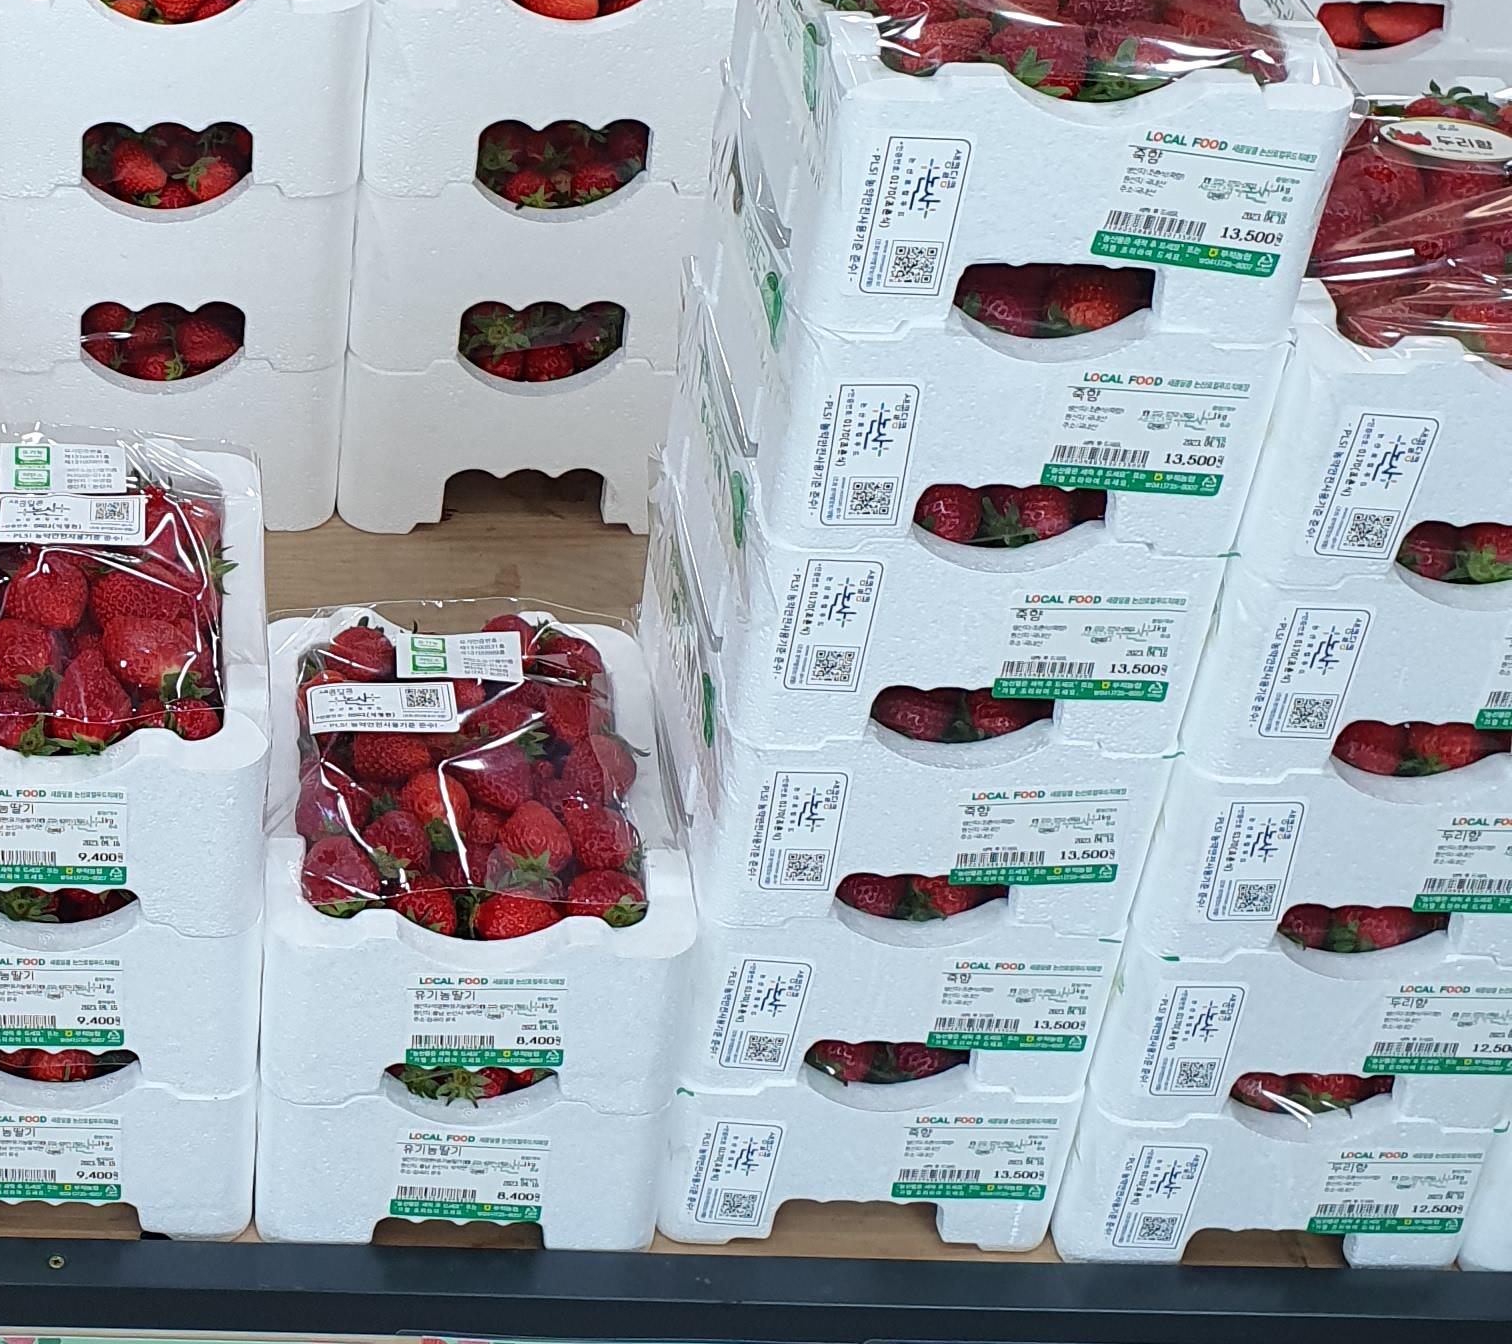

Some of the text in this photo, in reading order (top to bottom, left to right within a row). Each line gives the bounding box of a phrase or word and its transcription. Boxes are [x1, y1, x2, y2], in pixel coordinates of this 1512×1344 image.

[1146, 131, 1228, 151] LOCAL FOOD
[1436, 135, 1493, 150] 두리향
[1084, 371, 1163, 386] LOCAL FOOD
[1025, 594, 1102, 604] LOCAL FOOD
[16, 789, 46, 798] FOOD
[972, 790, 1045, 801] LOCAL FOOD
[1452, 817, 1490, 826] LOCAL
[17, 958, 46, 966] FOOD
[955, 961, 991, 970] LOCAL
[419, 977, 454, 985] LOCAL
[1399, 984, 1471, 994] LOCAL FOOD
[415, 990, 476, 1001] 유기농딸기
[916, 1116, 983, 1125] LOCAL FOOD
[409, 1133, 475, 1143] LOCAL FOOD
[403, 1144, 462, 1157] 유기농딸기
